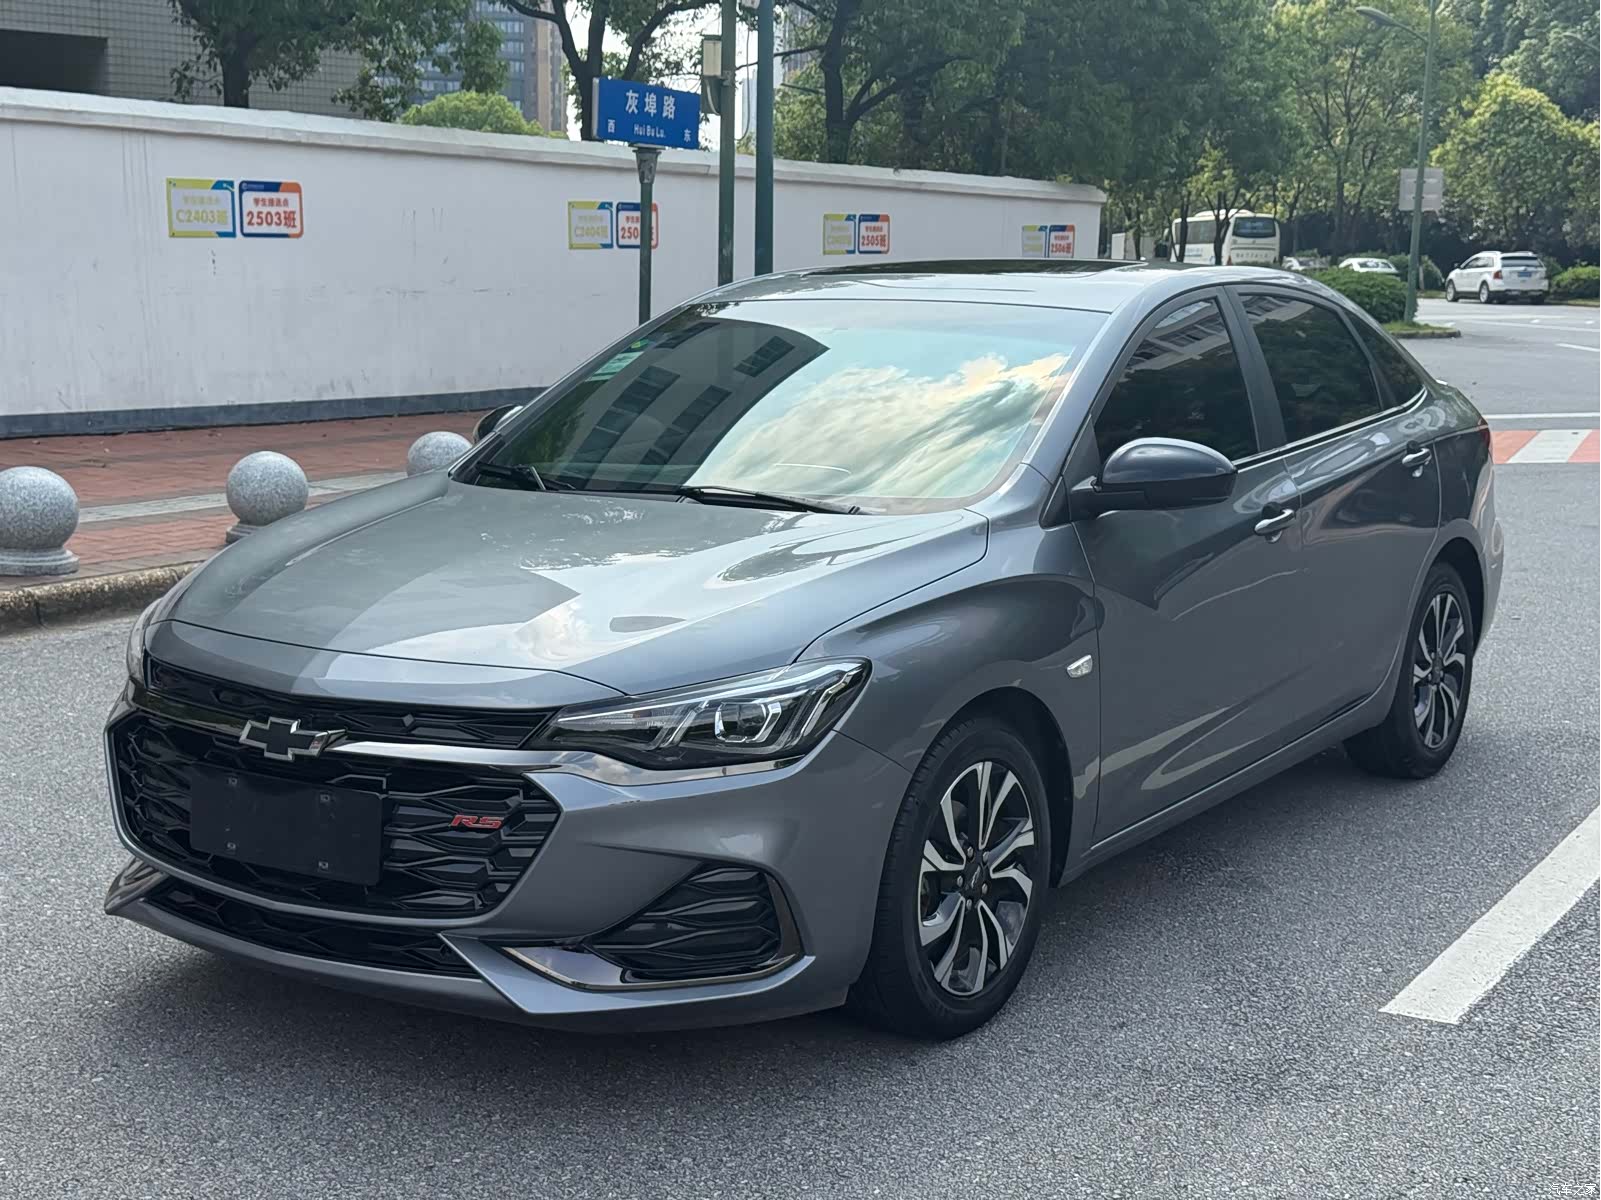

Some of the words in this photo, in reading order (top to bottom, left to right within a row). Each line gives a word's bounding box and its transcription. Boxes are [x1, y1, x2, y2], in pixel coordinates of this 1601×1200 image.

[625, 89, 676, 120] 灰埠路
[607, 119, 616, 133] 西
[634, 123, 645, 136] Hui
[646, 125, 655, 137] Bu
[684, 129, 692, 143] 东
[176, 209, 228, 226] C2403班
[246, 210, 297, 228] 2503班
[861, 234, 887, 248] 2505班
[451, 814, 504, 829] RS
